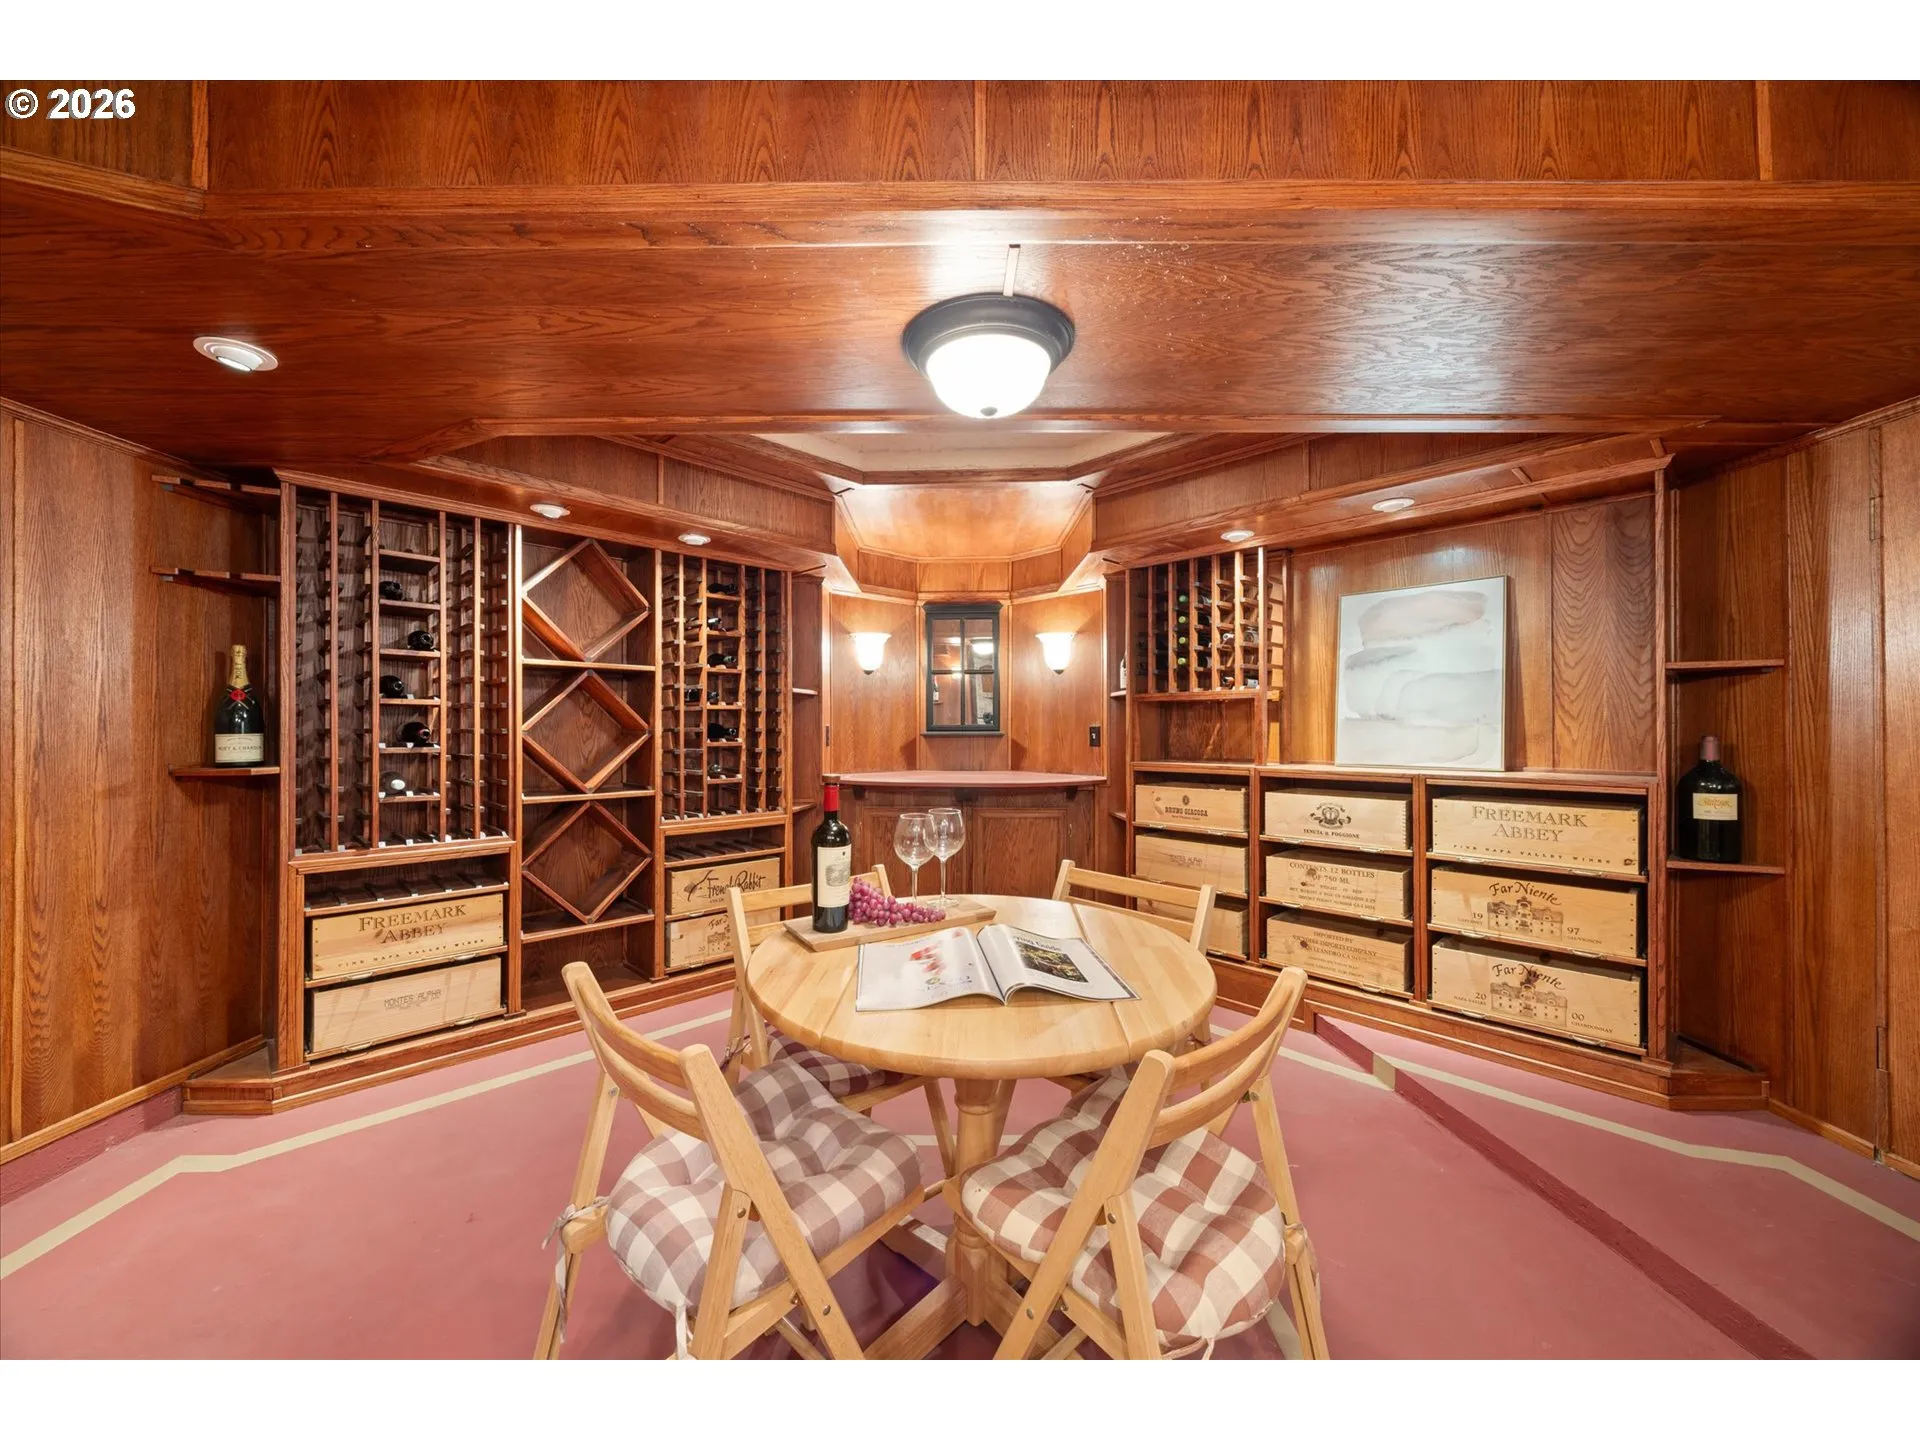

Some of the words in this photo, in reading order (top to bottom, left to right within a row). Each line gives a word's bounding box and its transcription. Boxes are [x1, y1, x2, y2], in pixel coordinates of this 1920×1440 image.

[1471, 805, 1589, 828] FREEMARK
[1492, 823, 1565, 843] ABBEY
[1485, 847, 1512, 855] NAPA
[1520, 851, 1564, 860] VALLEY
[735, 869, 766, 892] Rabbit
[1289, 862, 1328, 874] CONTENTS
[1330, 865, 1339, 874] 12
[1341, 867, 1376, 879] BOTTLES
[1324, 875, 1337, 883] 750
[1339, 877, 1350, 885] ML
[1489, 882, 1514, 897] Far
[1515, 881, 1563, 906] Niente
[358, 904, 467, 932] FREEMARK
[382, 922, 447, 944] ABBEY
[1567, 927, 1580, 936] 97
[1492, 964, 1515, 978] Far
[1515, 963, 1566, 990] Niente
[1475, 992, 1487, 1001] 20
